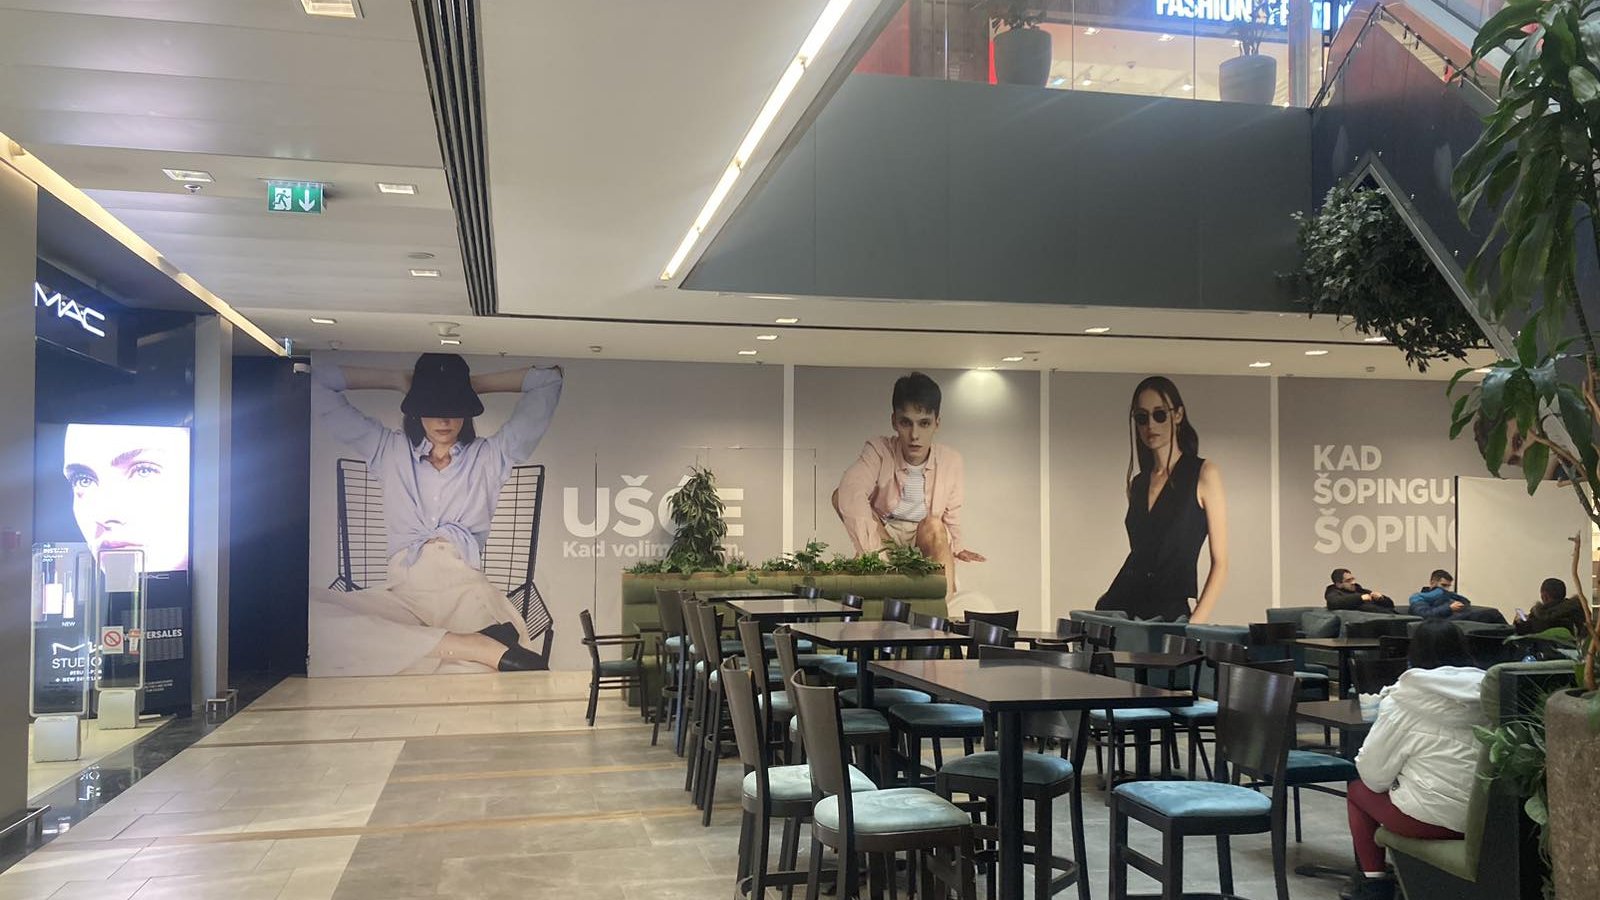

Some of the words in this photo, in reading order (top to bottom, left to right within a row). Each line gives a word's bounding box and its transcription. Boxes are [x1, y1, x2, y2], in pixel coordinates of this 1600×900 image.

[1313, 445, 1382, 471] KAD
[1313, 508, 1456, 553] ŠOPIN
[563, 541, 606, 558] Kad
